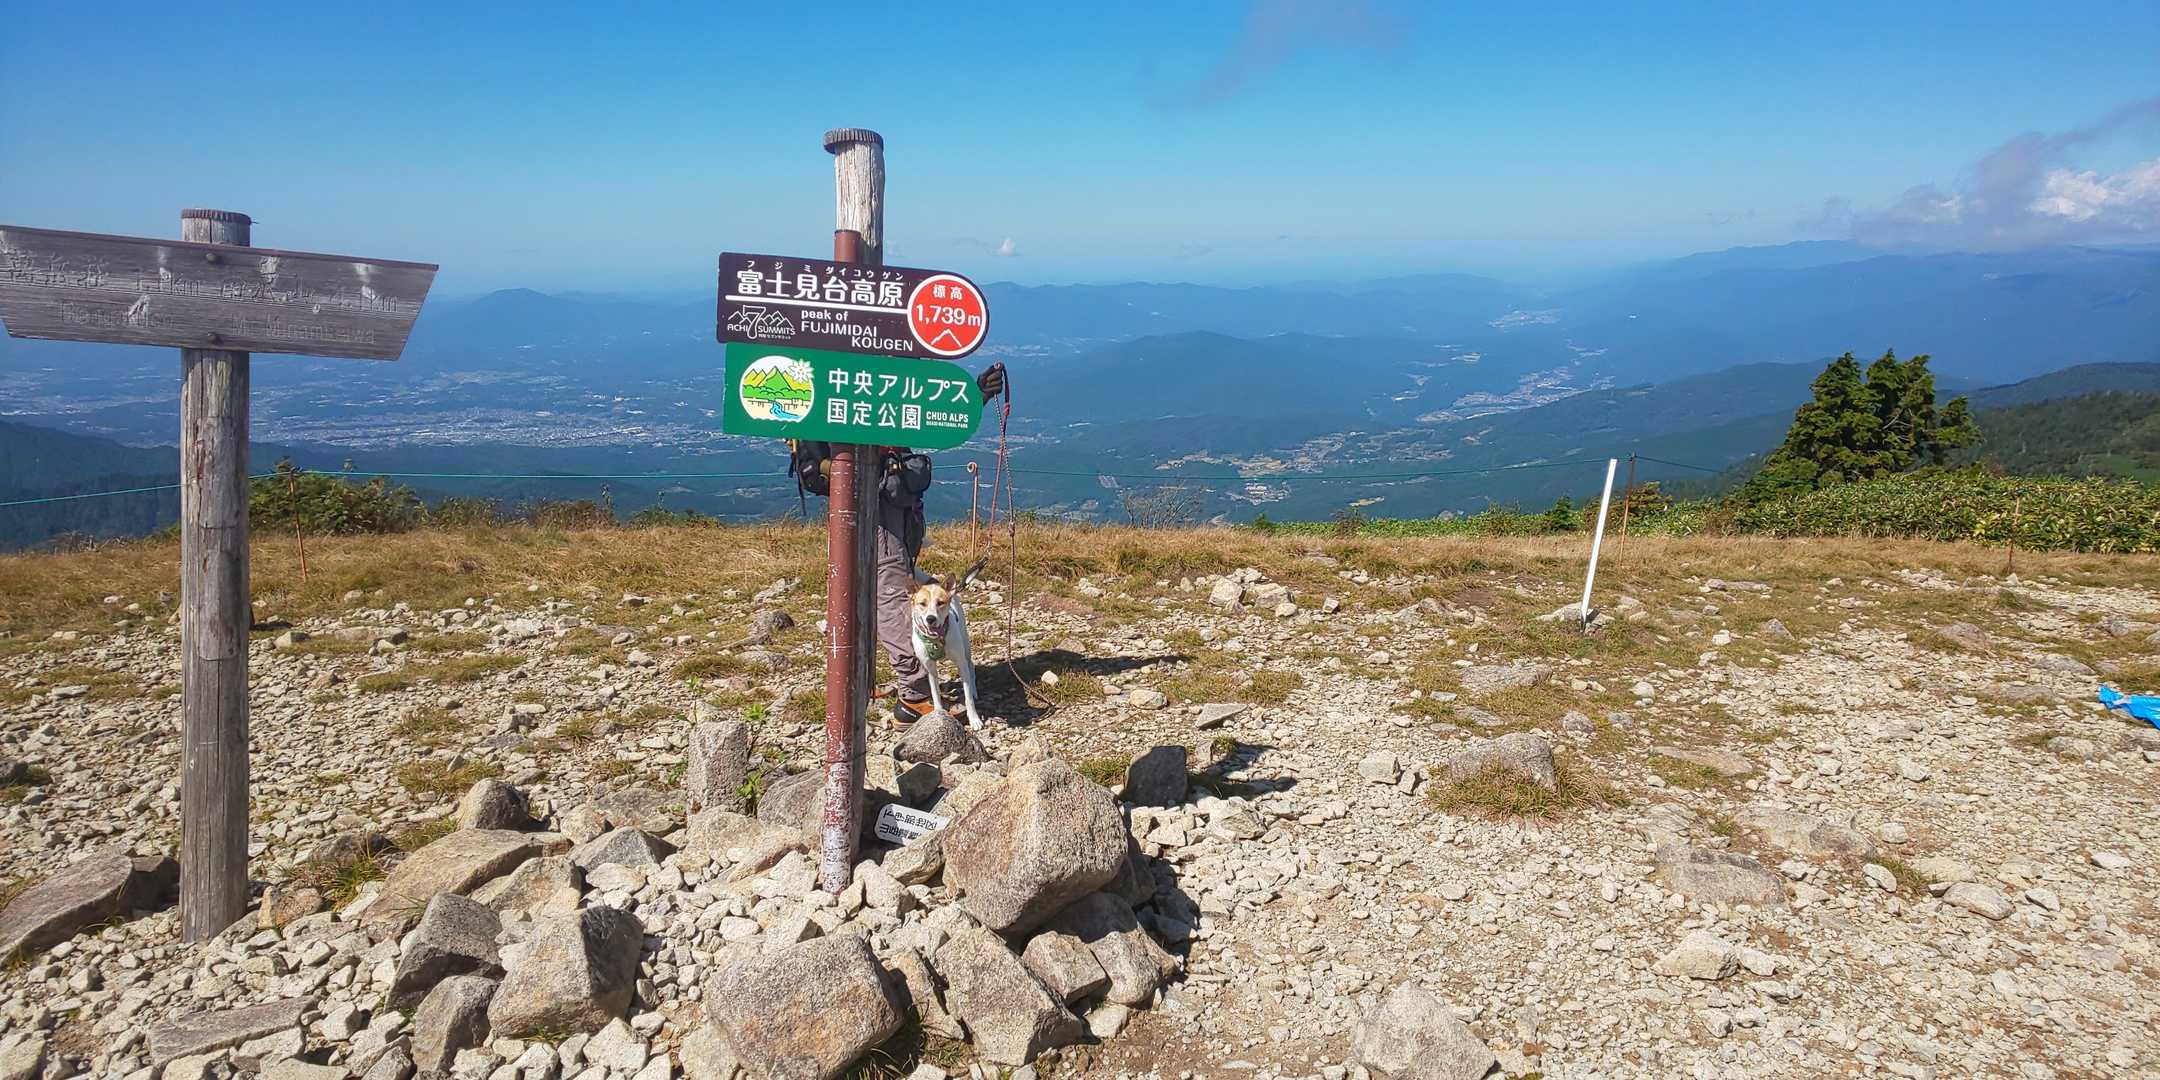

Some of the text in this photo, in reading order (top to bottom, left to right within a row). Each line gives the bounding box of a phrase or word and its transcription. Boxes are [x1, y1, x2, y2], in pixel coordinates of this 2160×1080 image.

[737, 269, 904, 307] 富士見台高原
[932, 284, 963, 300] 標高
[801, 309, 849, 322] peak of
[727, 323, 796, 336] ACHI SUMMITS
[801, 321, 877, 337] FUJIMIDAI
[852, 336, 913, 351] KOUGEN
[828, 368, 969, 404] 中央アルプス
[827, 398, 921, 430] 国定公園
[926, 411, 969, 423] CHUO ALPS
